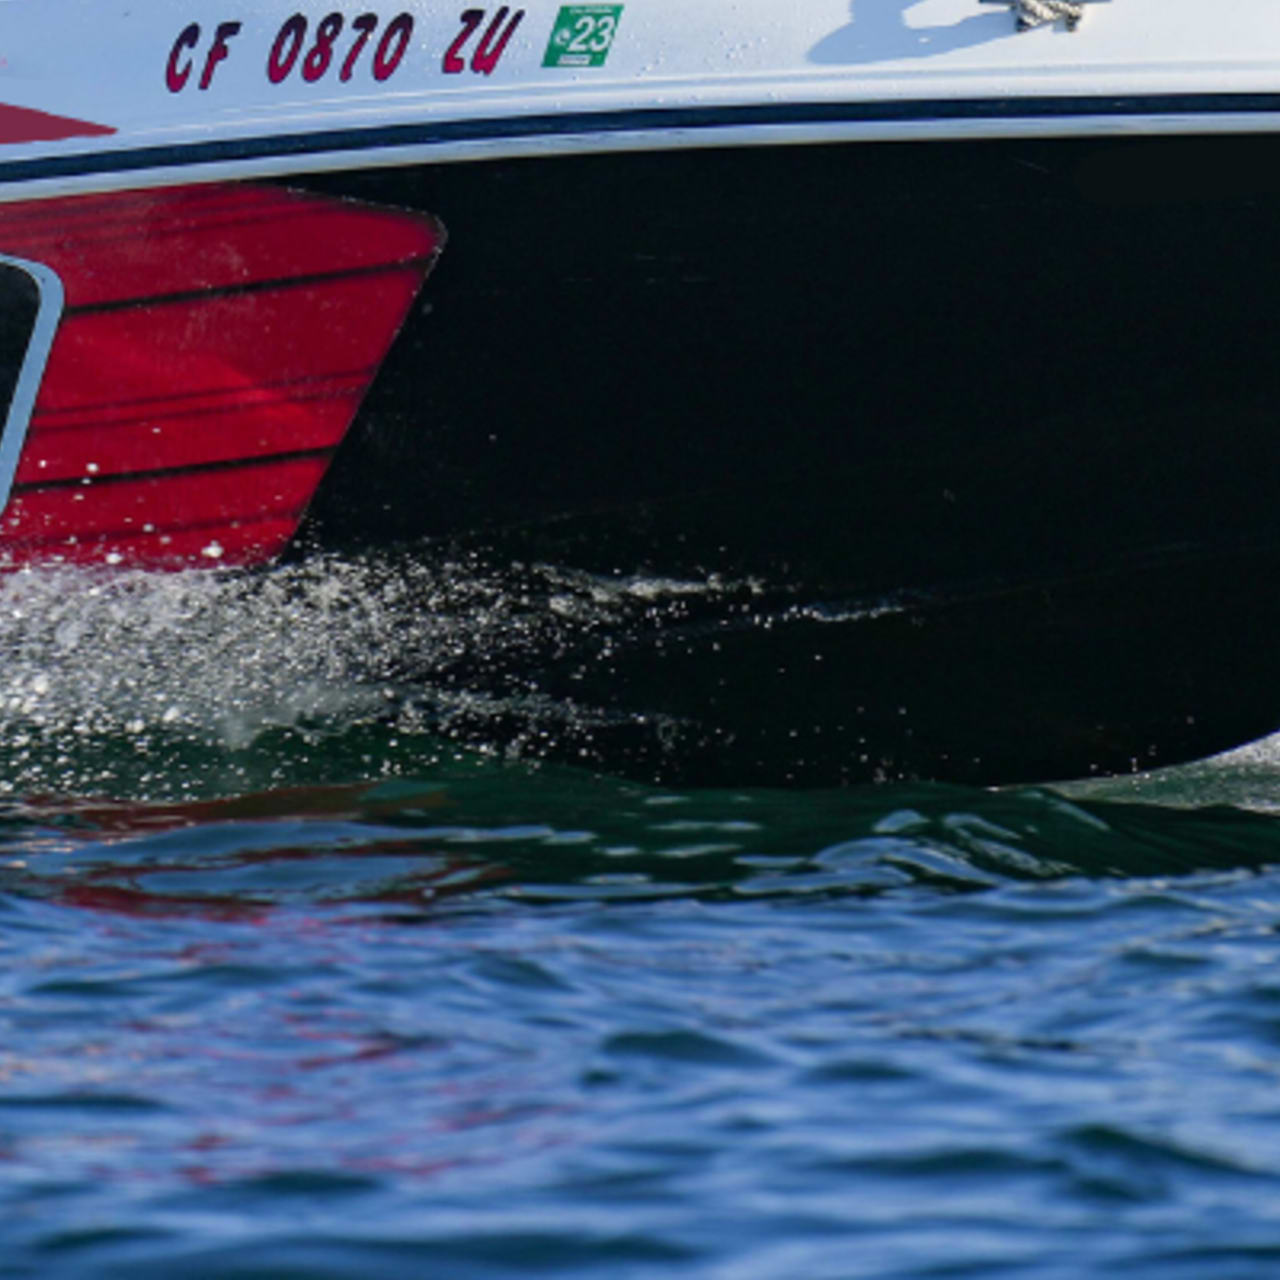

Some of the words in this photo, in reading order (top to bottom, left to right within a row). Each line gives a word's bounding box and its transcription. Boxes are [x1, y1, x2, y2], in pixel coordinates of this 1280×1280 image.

[165, 21, 242, 93] CF
[266, 11, 414, 84] 0870
[441, 5, 525, 76] ZU
[567, 16, 615, 51] 23
